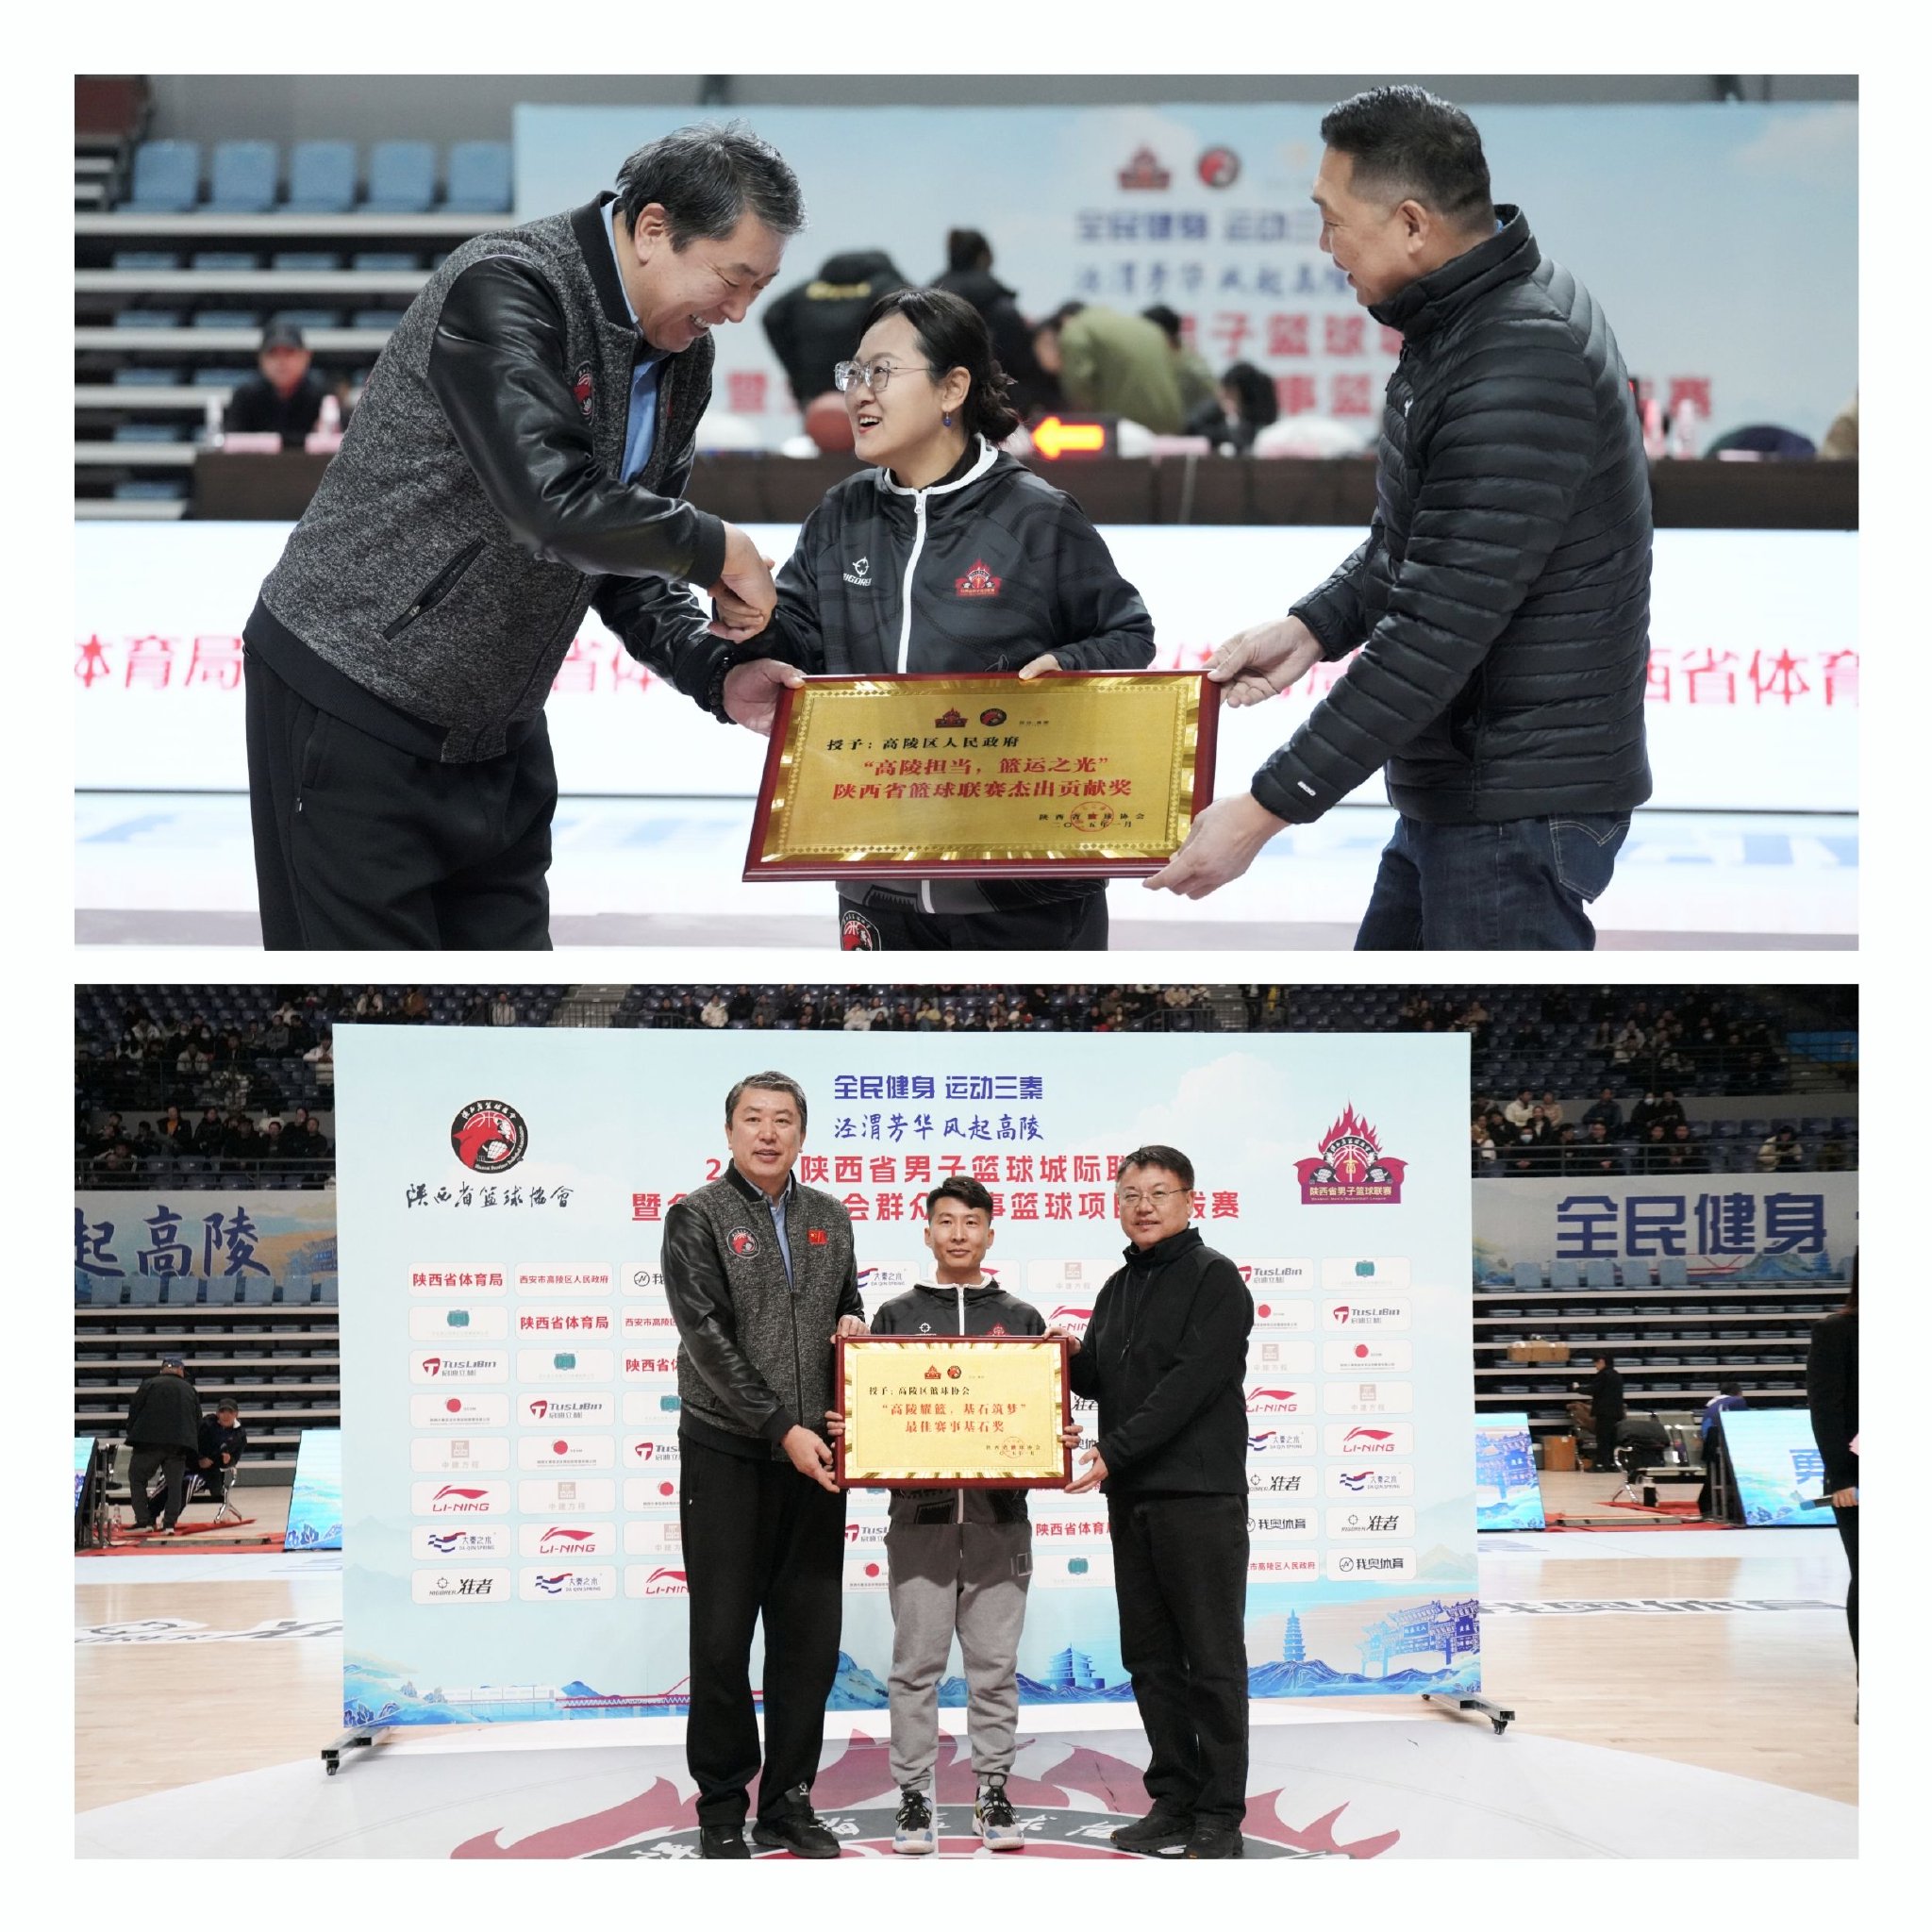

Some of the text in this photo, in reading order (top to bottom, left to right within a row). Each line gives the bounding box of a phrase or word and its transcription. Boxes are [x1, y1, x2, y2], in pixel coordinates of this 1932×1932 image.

[833, 780, 1132, 800] 陕西省篮球联赛杰出贡献奖
[835, 1074, 1042, 1099] 全民健身 运动三秦
[835, 1112, 1044, 1141] 泾渭芳华 风起高陵
[1556, 1192, 1826, 1259] 全民健身
[75, 1205, 271, 1276] 起高陵
[412, 1273, 503, 1287] 陕西省体育局
[520, 1275, 608, 1285] 西安市高陵区人民政府
[520, 1316, 609, 1329] 陕西省体育局
[1342, 1443, 1395, 1453] LI-NING
[432, 1503, 490, 1512] LI-NING
[1036, 1522, 1110, 1536] 陕西省体育
[540, 1543, 595, 1554] LI-NING
[1246, 1561, 1316, 1571] 市高陵区人民政府
[458, 1578, 493, 1594] 准者
